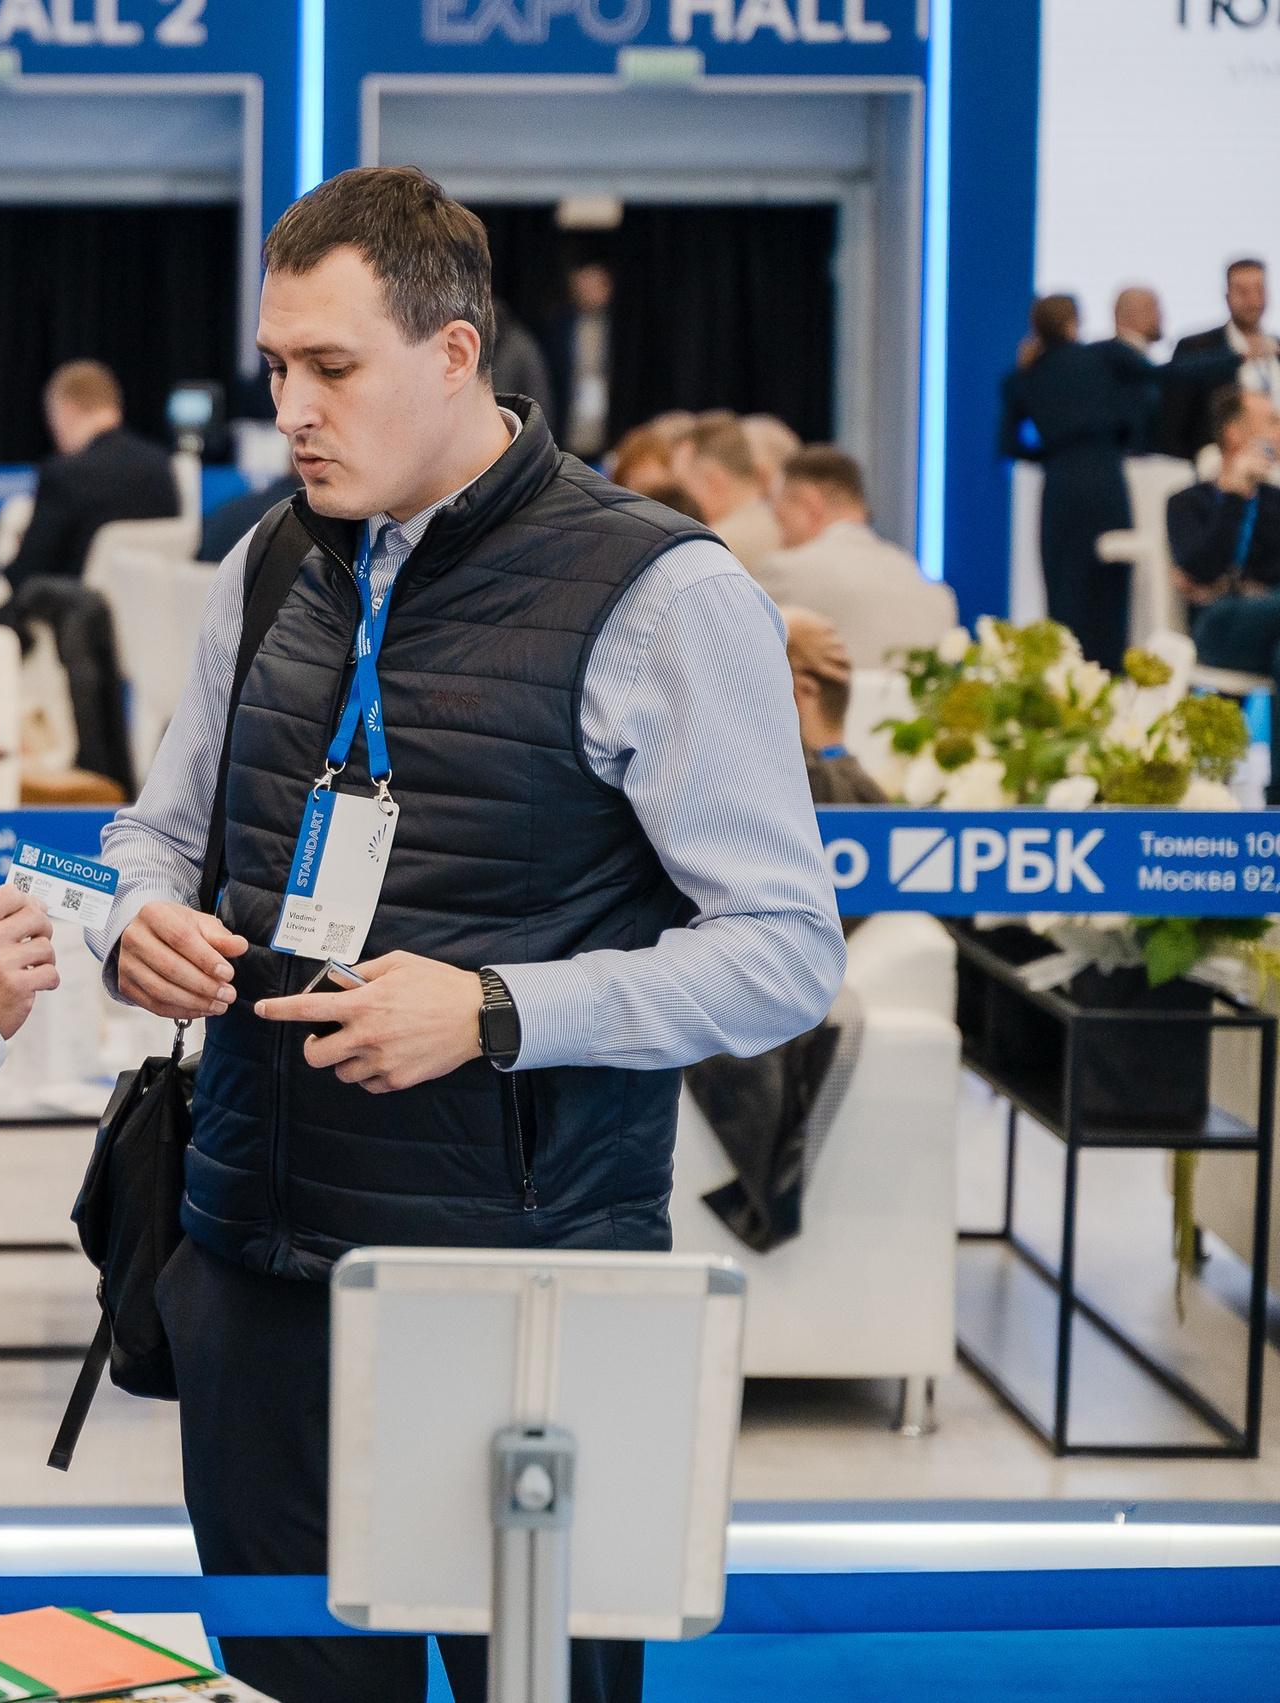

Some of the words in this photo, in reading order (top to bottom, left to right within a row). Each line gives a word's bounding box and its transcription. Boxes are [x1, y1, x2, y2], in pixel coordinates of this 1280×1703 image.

[154, 0, 208, 45] 2
[669, 0, 891, 43] HALL
[296, 809, 325, 888] STANDART
[1139, 830, 1239, 858] Тюмень
[41, 852, 112, 883] ITVGROUP
[960, 827, 1106, 893] РБК
[1138, 865, 1236, 892] Москва
[286, 922, 315, 933] Litvinyuk
[289, 912, 317, 922] Vladimir
